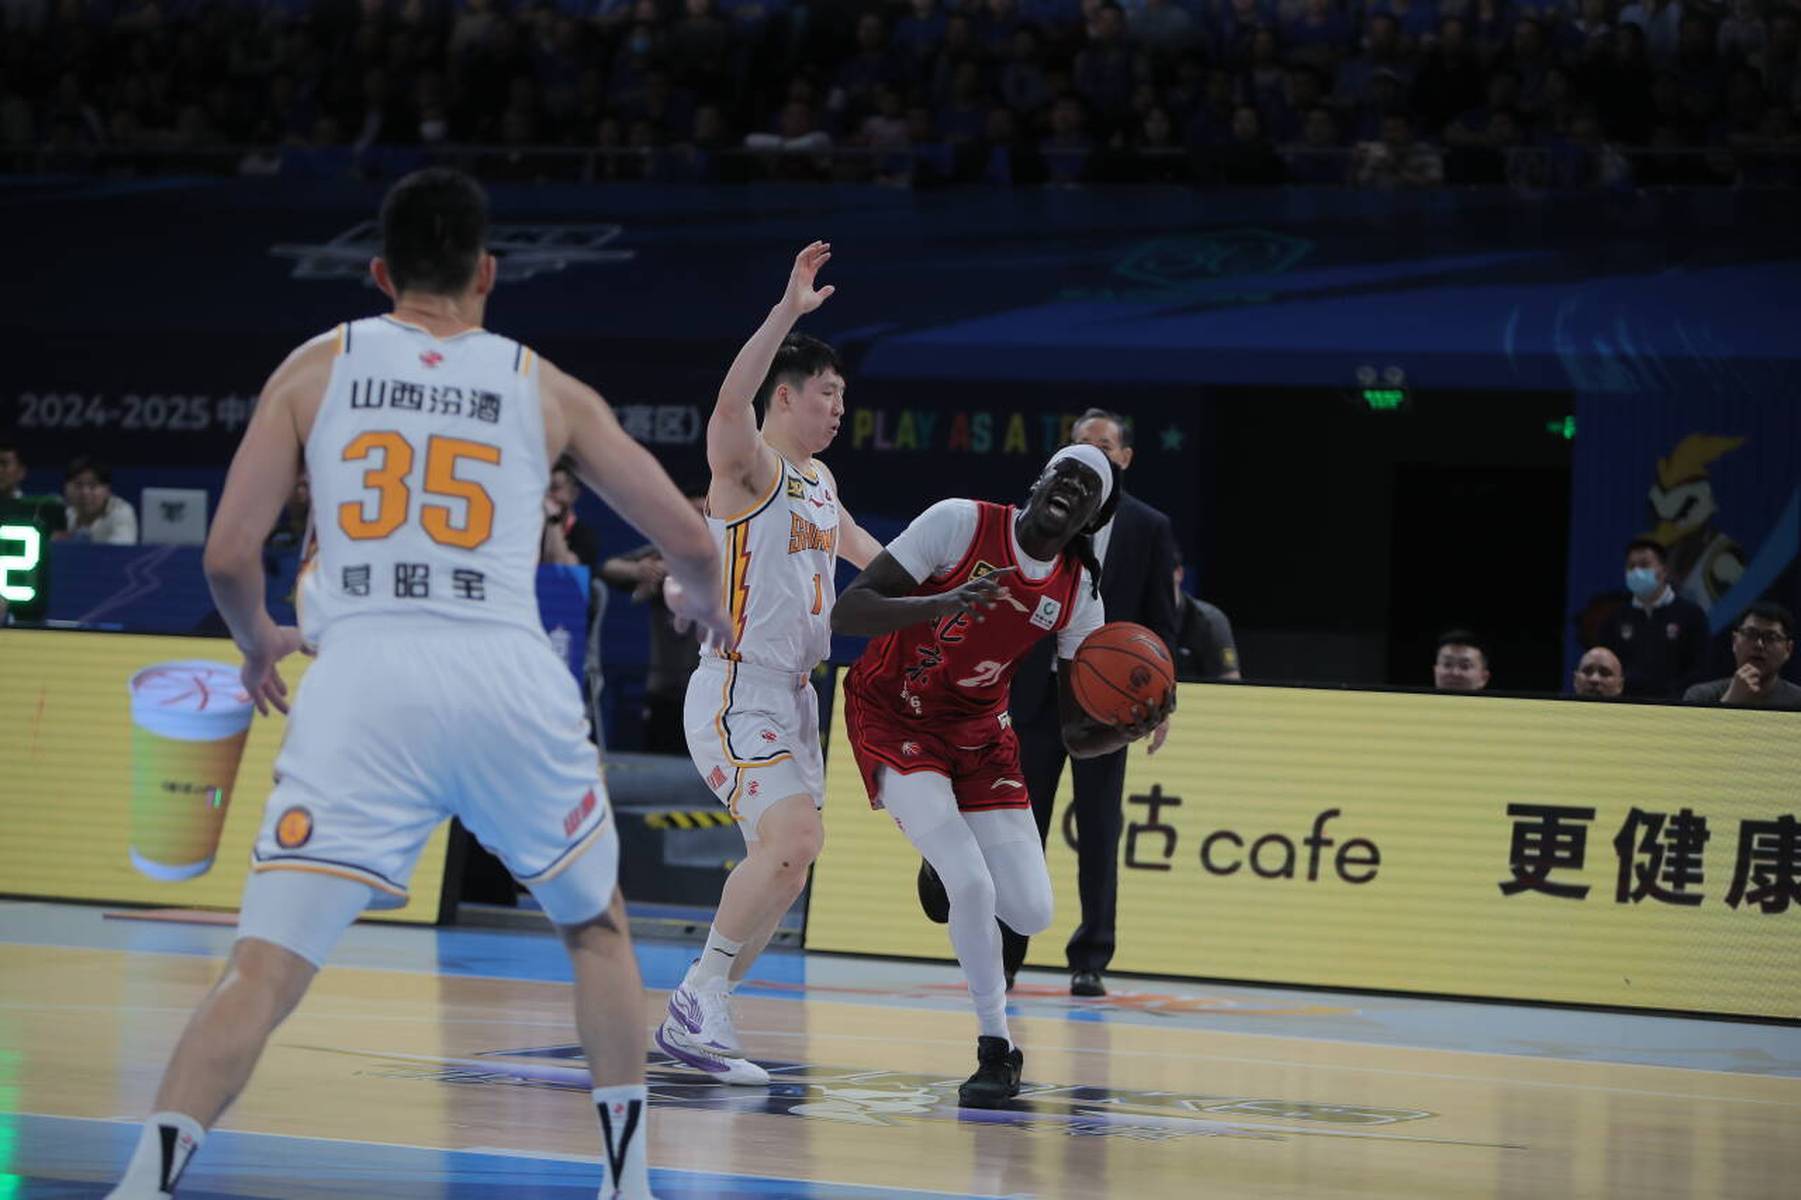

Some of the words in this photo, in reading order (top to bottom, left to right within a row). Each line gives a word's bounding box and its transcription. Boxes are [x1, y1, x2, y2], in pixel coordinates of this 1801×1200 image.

[17, 391, 211, 430] 2024-2025
[351, 378, 502, 424] 山西汾酒
[852, 407, 936, 451] PLAY
[950, 410, 992, 453] AS
[1004, 412, 1028, 455] A
[339, 431, 501, 550] 35
[0, 524, 41, 602] 2
[811, 573, 822, 615] 1
[1201, 808, 1381, 884] cafe
[1498, 803, 1801, 914] 更健康
